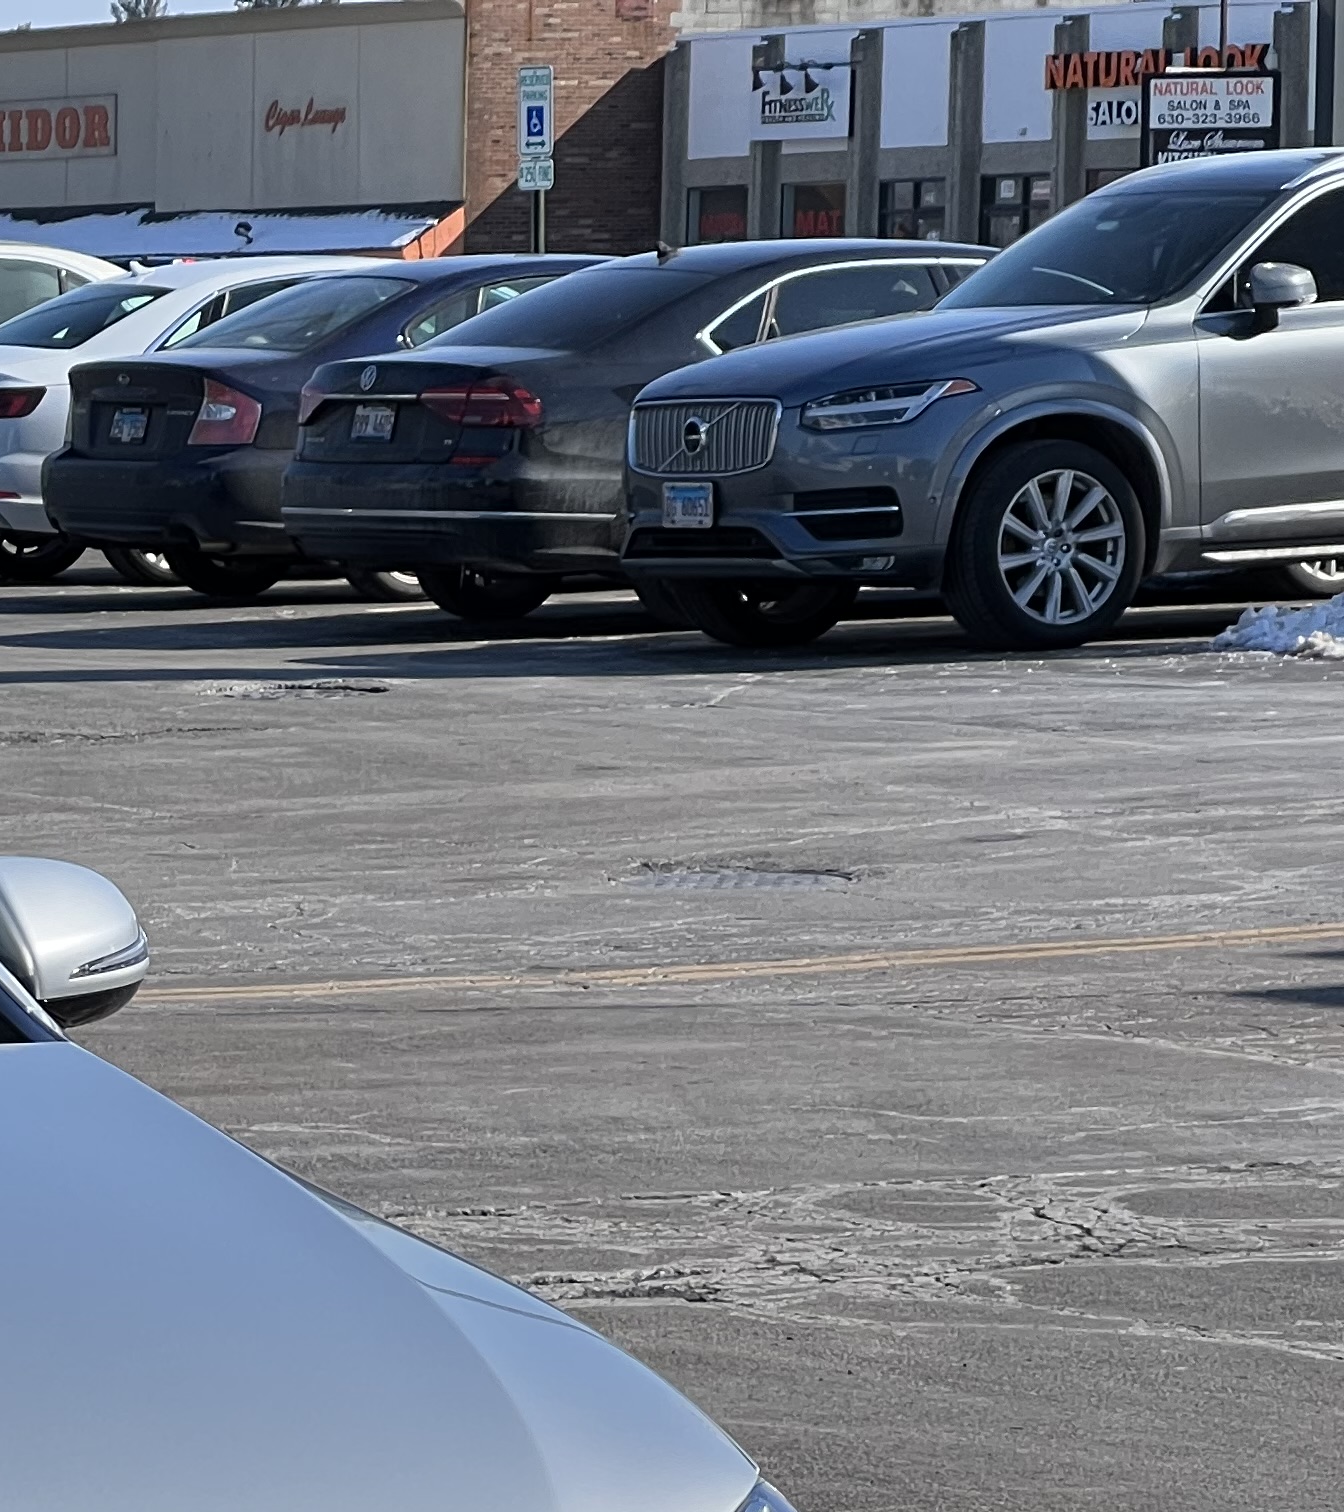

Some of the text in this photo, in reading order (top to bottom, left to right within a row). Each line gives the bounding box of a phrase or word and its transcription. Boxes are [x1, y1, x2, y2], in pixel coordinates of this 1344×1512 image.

[1045, 48, 1172, 90] NATURAL
[1152, 80, 1265, 97] NATURAL LOOK
[1167, 99, 1251, 112] SALON & SPA
